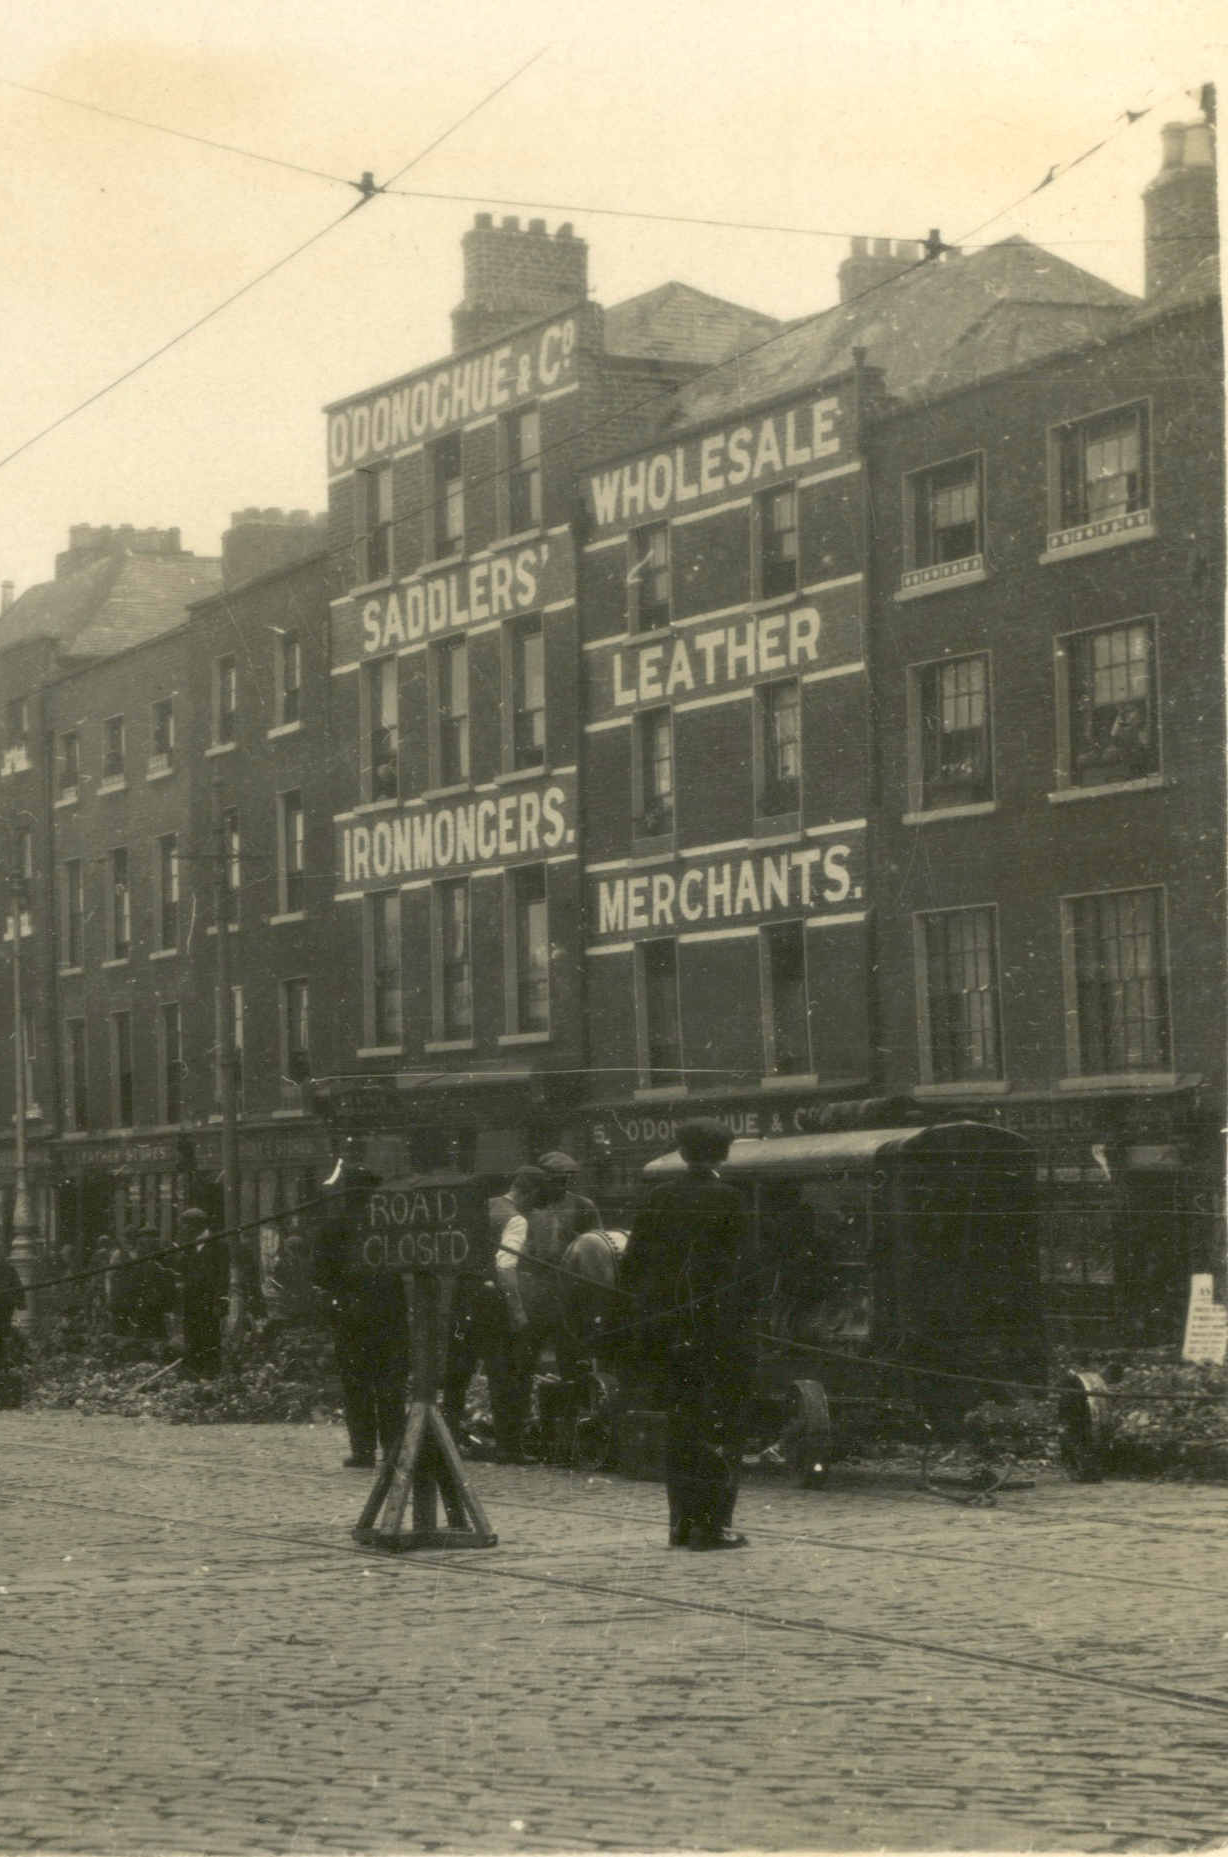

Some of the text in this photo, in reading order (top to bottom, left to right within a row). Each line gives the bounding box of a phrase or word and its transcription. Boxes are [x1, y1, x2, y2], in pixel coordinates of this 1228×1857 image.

[516, 353, 532, 396] &
[591, 396, 841, 525] WHOLESALE
[362, 543, 549, 653] SADDLERS'
[613, 607, 821, 707] LEATHER
[344, 787, 575, 882] IRONMONGERS.
[598, 845, 863, 933] MERCHANTS.
[771, 1112, 784, 1133] &
[363, 1230, 470, 1267] CLOSED
[369, 1189, 458, 1227] ROAD
